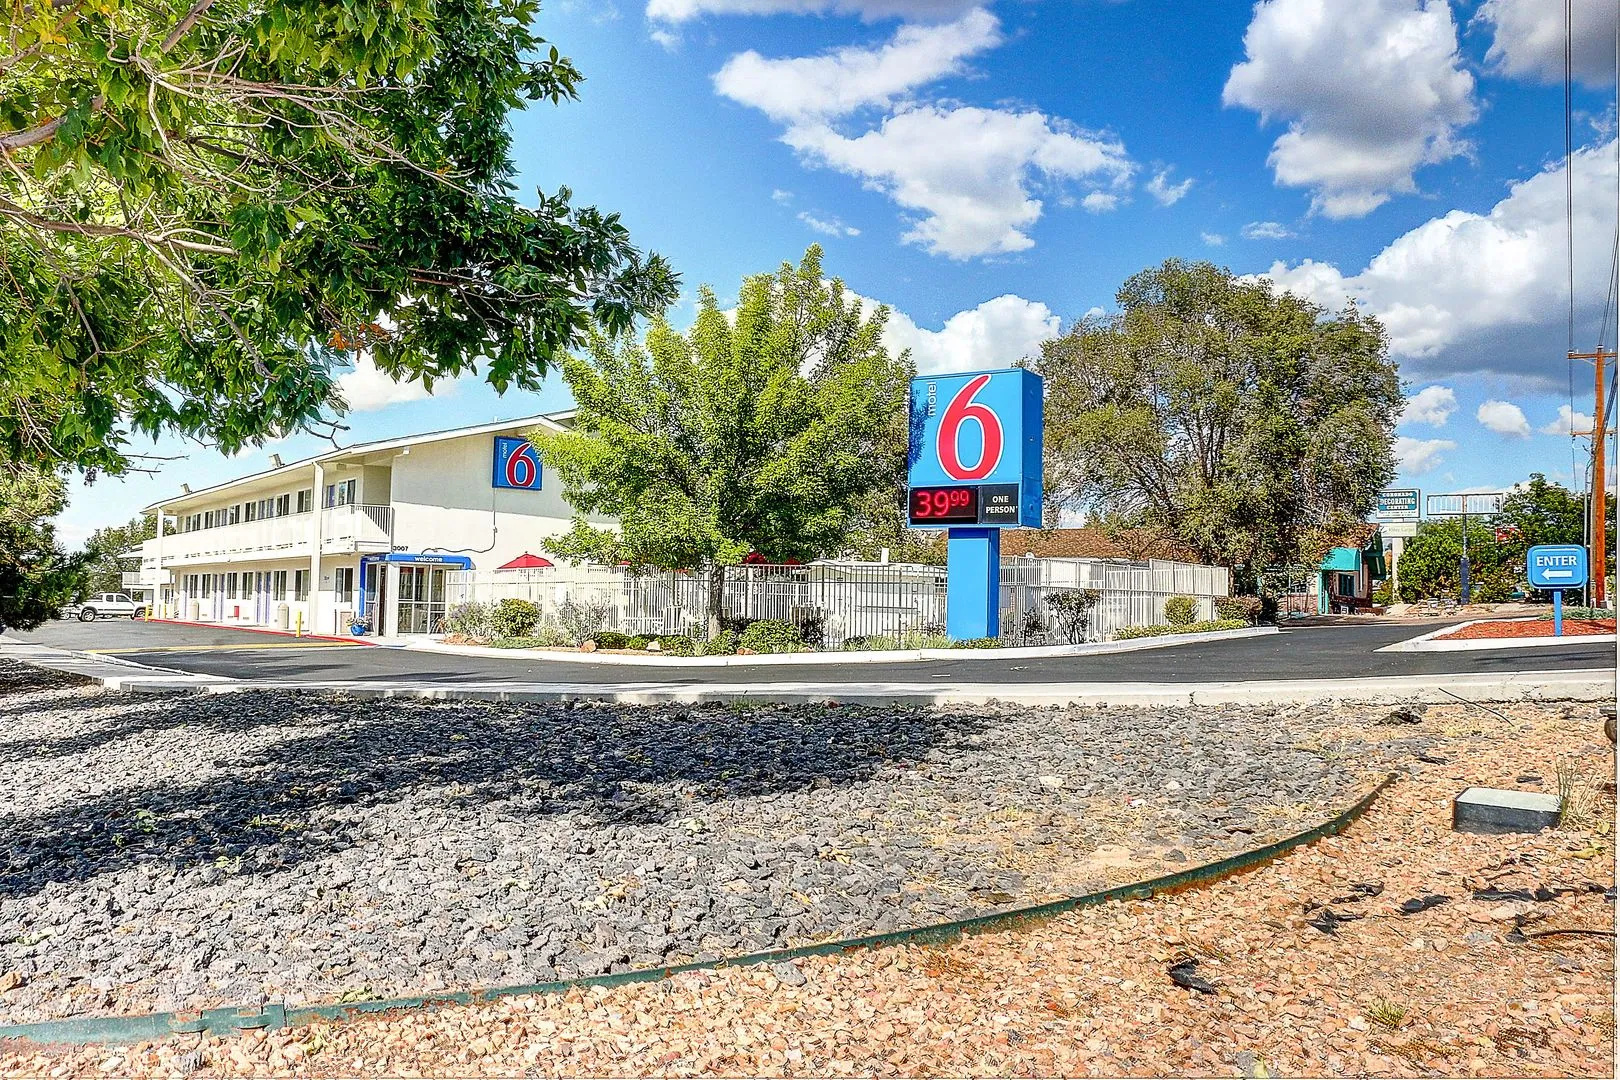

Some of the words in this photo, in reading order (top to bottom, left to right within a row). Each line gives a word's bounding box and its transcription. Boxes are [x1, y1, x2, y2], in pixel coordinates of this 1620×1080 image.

[927, 381, 936, 416] motel
[935, 373, 1004, 481] 6
[505, 441, 537, 488] 6
[992, 495, 1009, 503] ONE
[1379, 497, 1416, 505] DECORATING
[1536, 555, 1578, 567] ENTER
